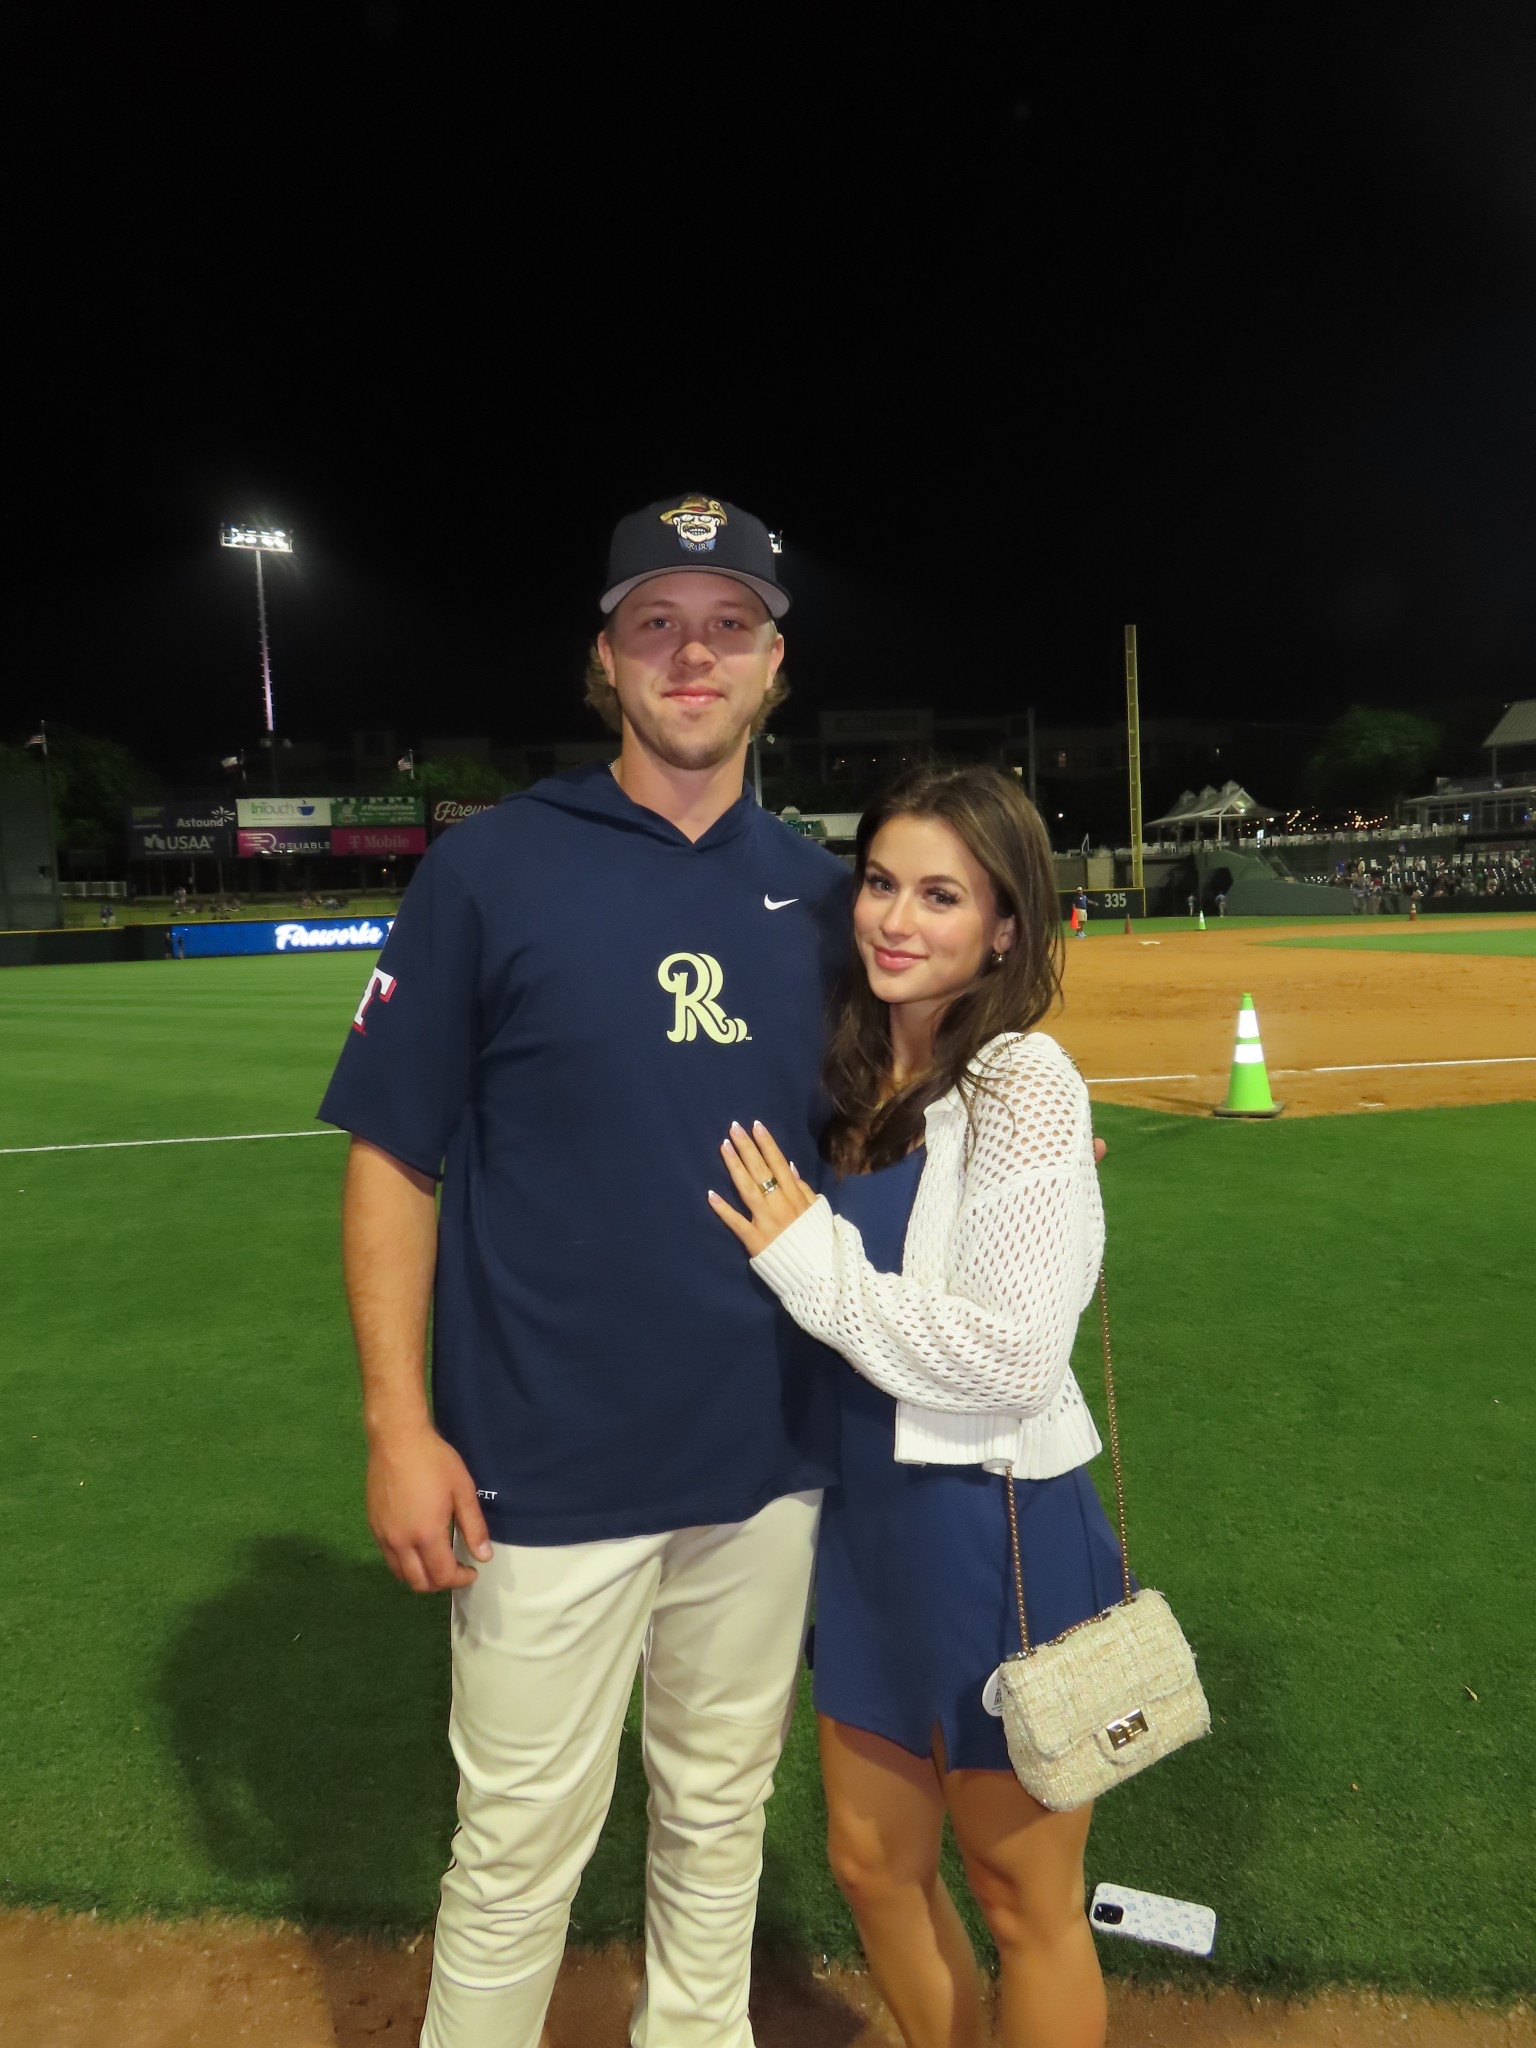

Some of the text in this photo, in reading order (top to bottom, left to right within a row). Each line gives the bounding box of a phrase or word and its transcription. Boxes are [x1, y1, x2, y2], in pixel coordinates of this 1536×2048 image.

[251, 802, 295, 815] InTouch
[176, 818, 224, 828] Astound
[167, 835, 211, 850] USAA
[1104, 893, 1127, 908] 335
[275, 921, 384, 951] Fireworks
